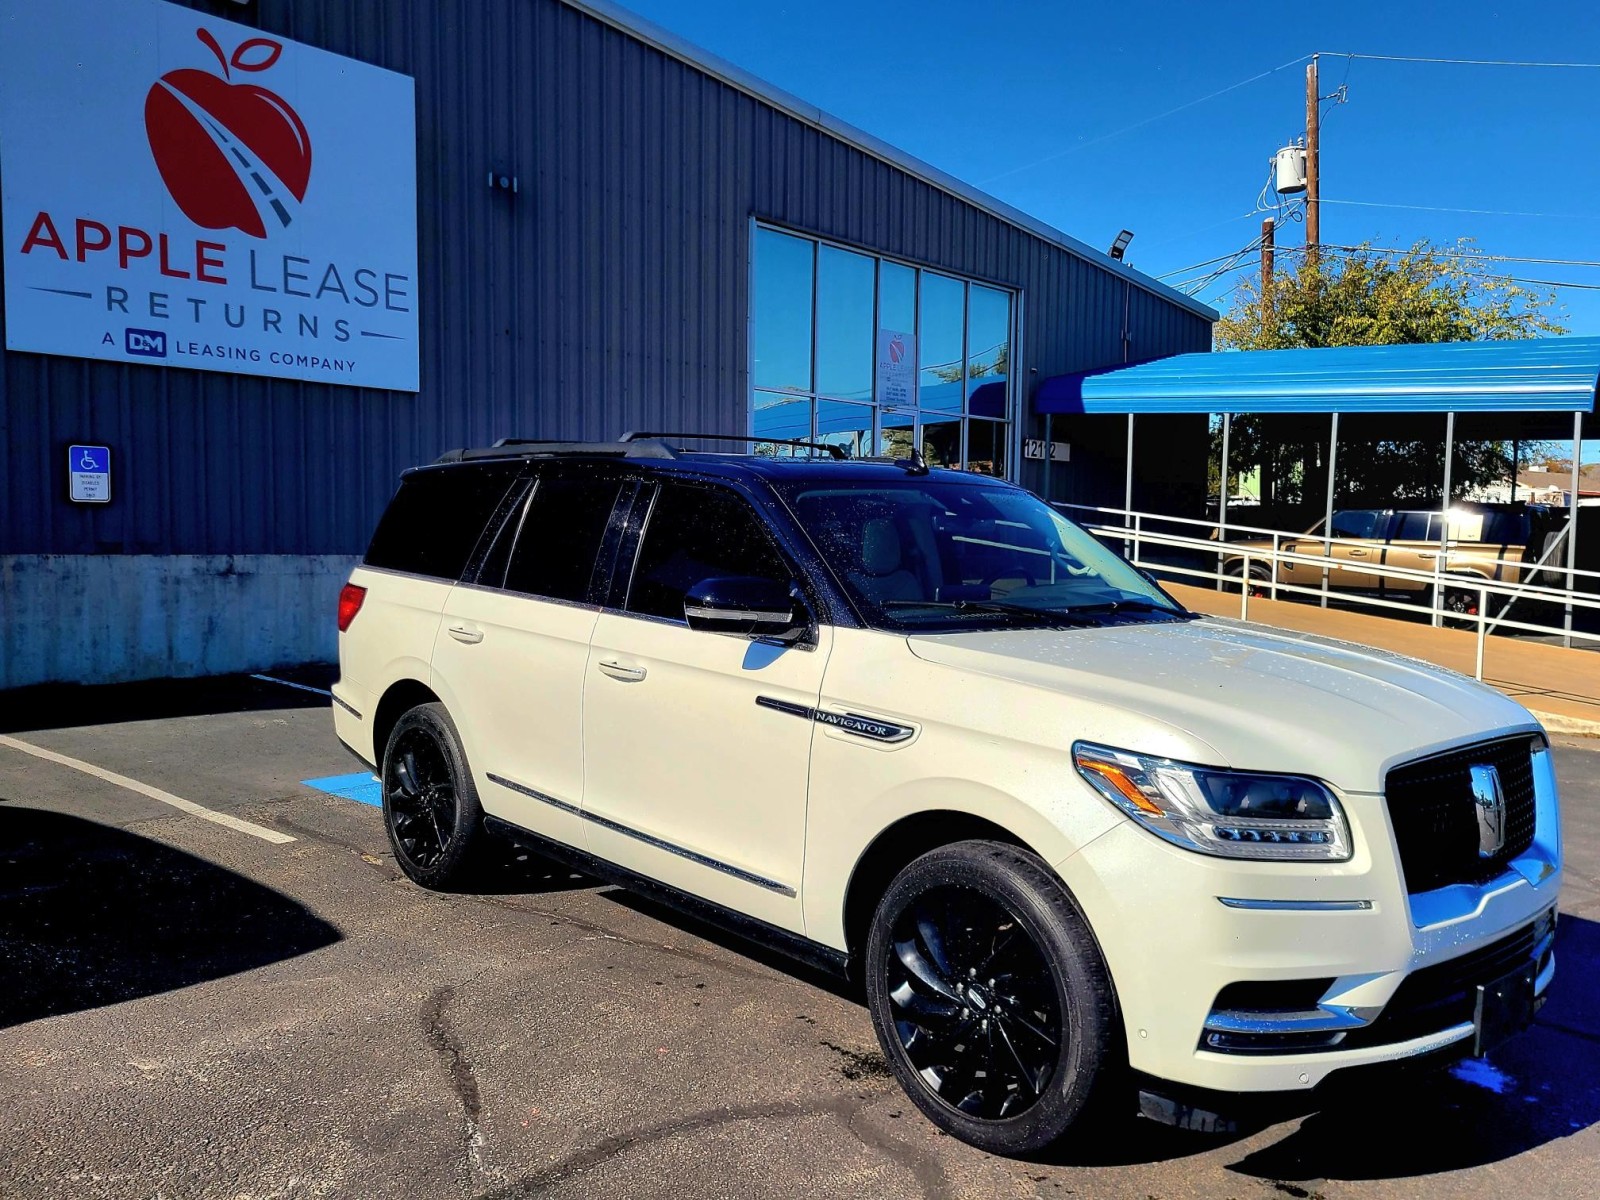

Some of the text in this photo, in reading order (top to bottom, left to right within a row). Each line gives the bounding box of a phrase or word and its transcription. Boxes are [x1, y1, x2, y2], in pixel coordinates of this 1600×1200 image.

[20, 210, 410, 313] APPLE LEASE
[105, 285, 350, 343] RETURNS
[101, 331, 115, 346] A
[176, 340, 261, 362] LEASING
[269, 351, 356, 373] COMPANY
[1024, 440, 1056, 459] 1212
[815, 712, 887, 735] NAVIGATOR
